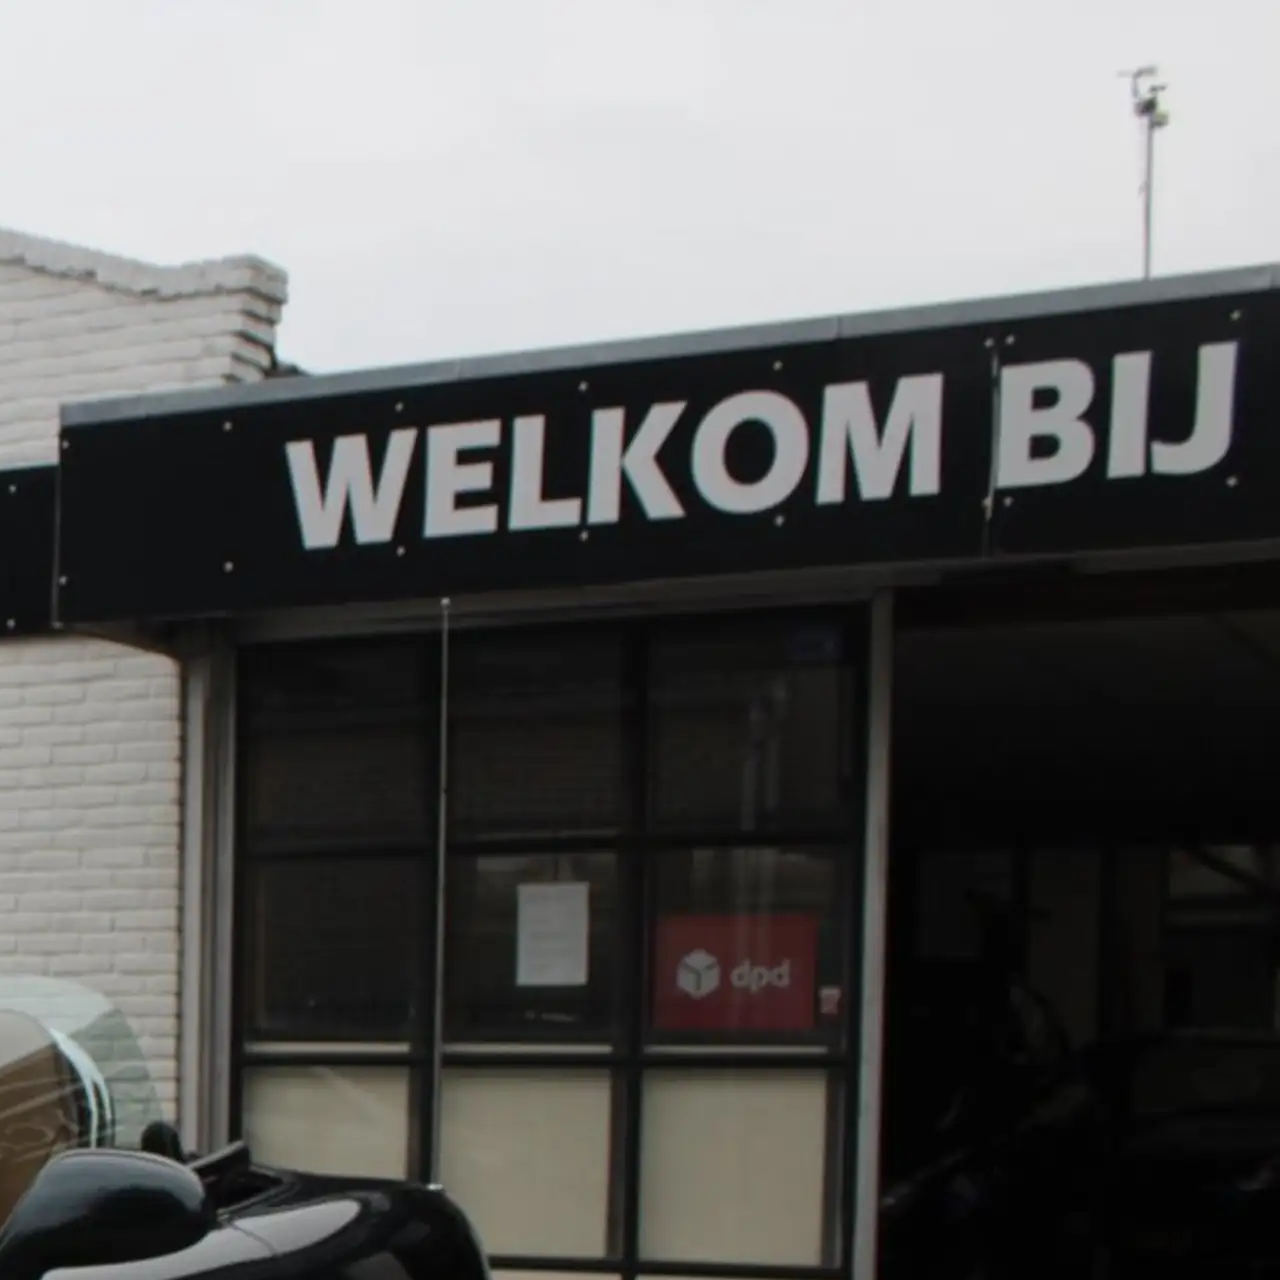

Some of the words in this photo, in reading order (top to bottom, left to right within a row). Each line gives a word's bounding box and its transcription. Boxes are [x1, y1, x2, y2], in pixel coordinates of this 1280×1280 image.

[286, 373, 944, 549] WELKOM
[995, 341, 1238, 489] BIJ
[730, 958, 791, 992] dpd
